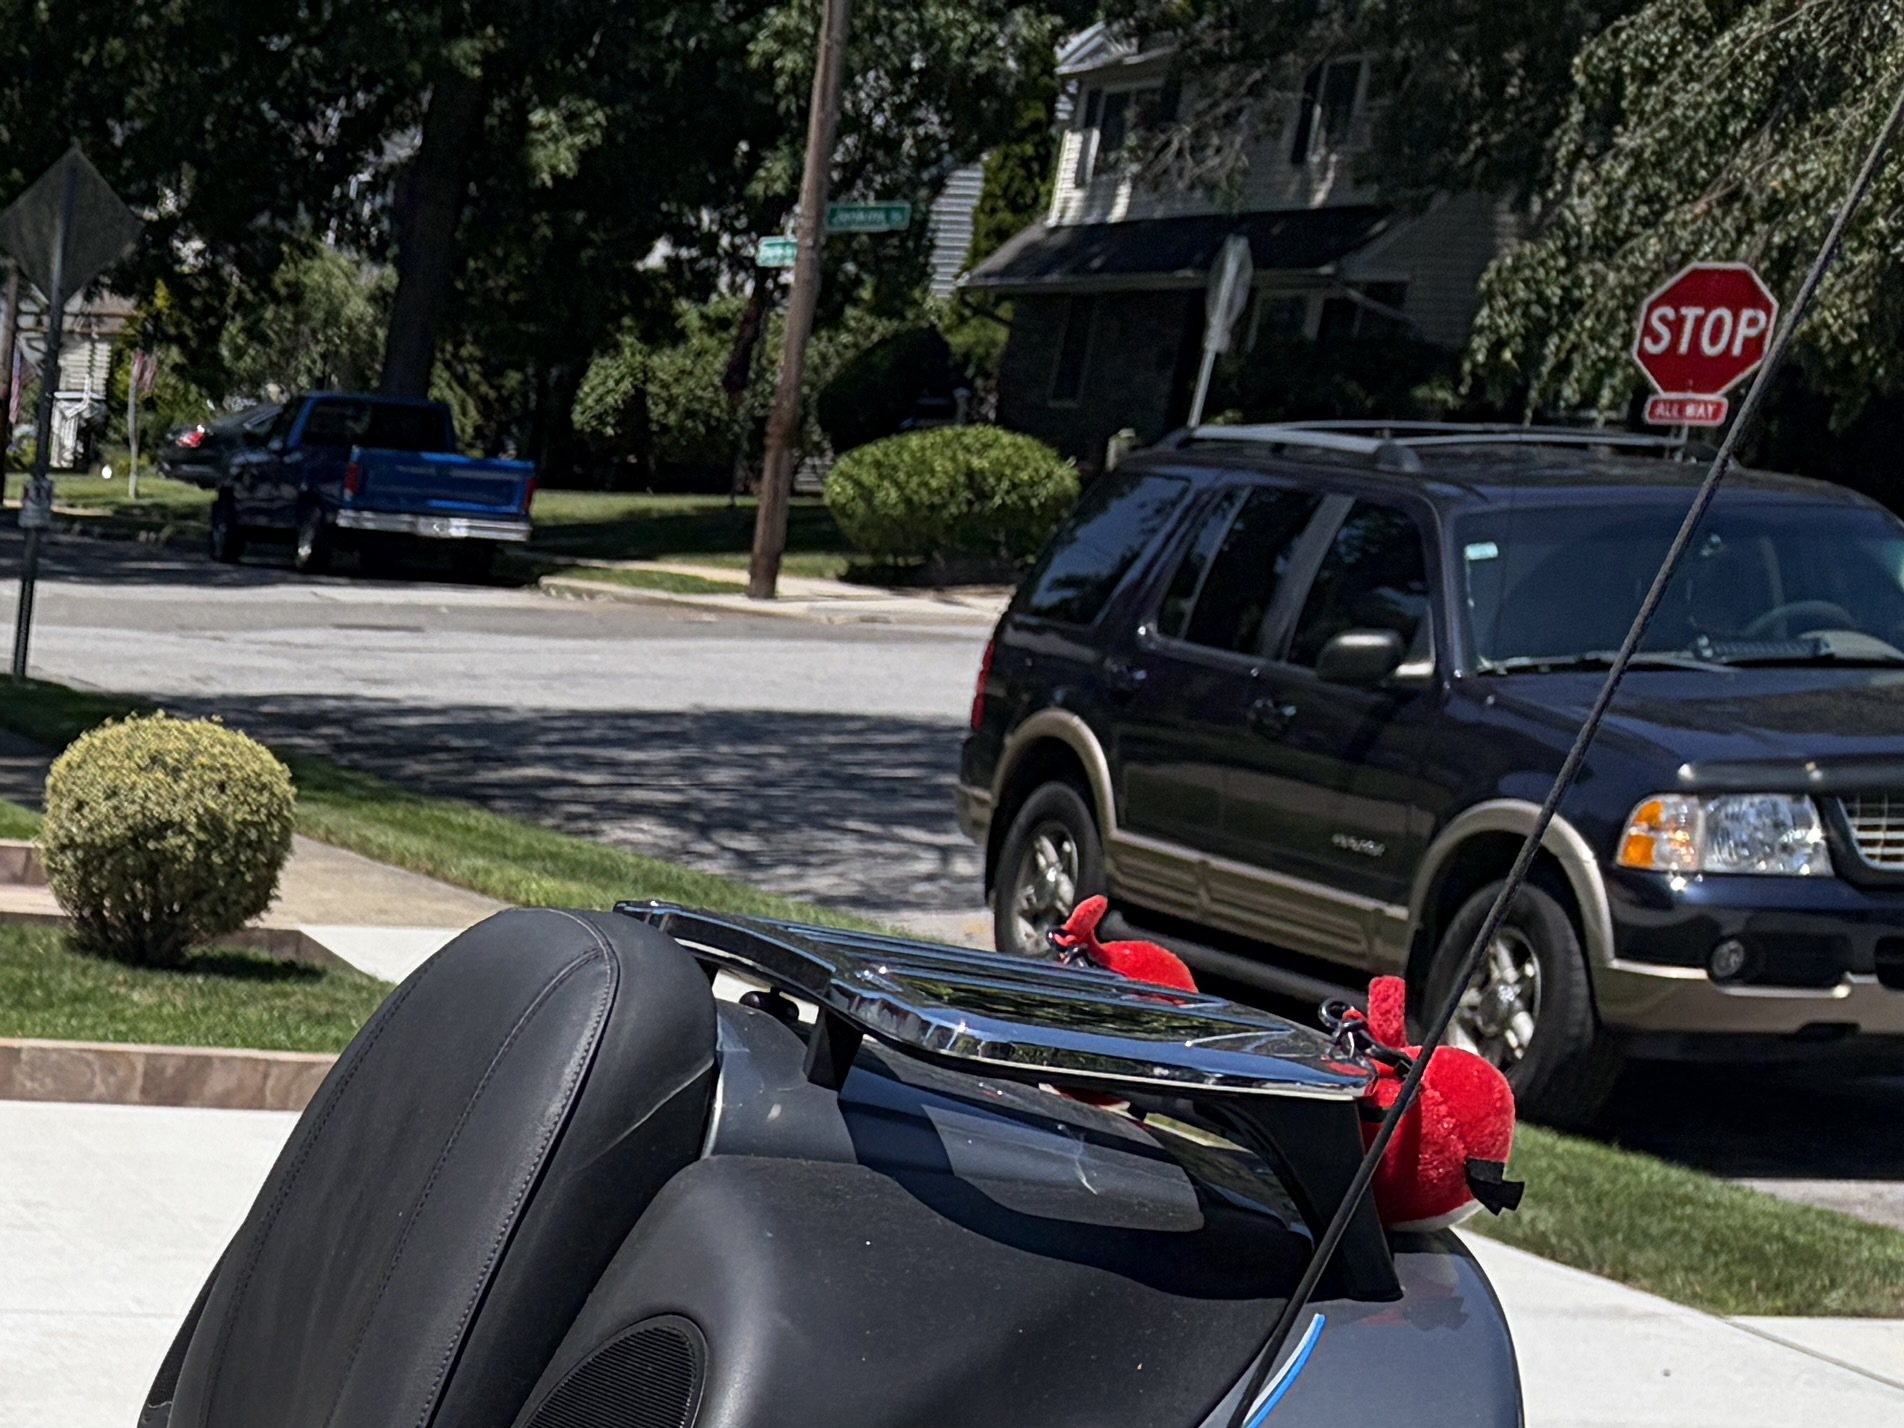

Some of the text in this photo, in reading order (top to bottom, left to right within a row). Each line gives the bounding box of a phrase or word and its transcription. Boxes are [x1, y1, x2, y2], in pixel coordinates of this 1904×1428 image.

[1643, 305, 1768, 358] STOP
[1655, 402, 1717, 418] ALL WAY
